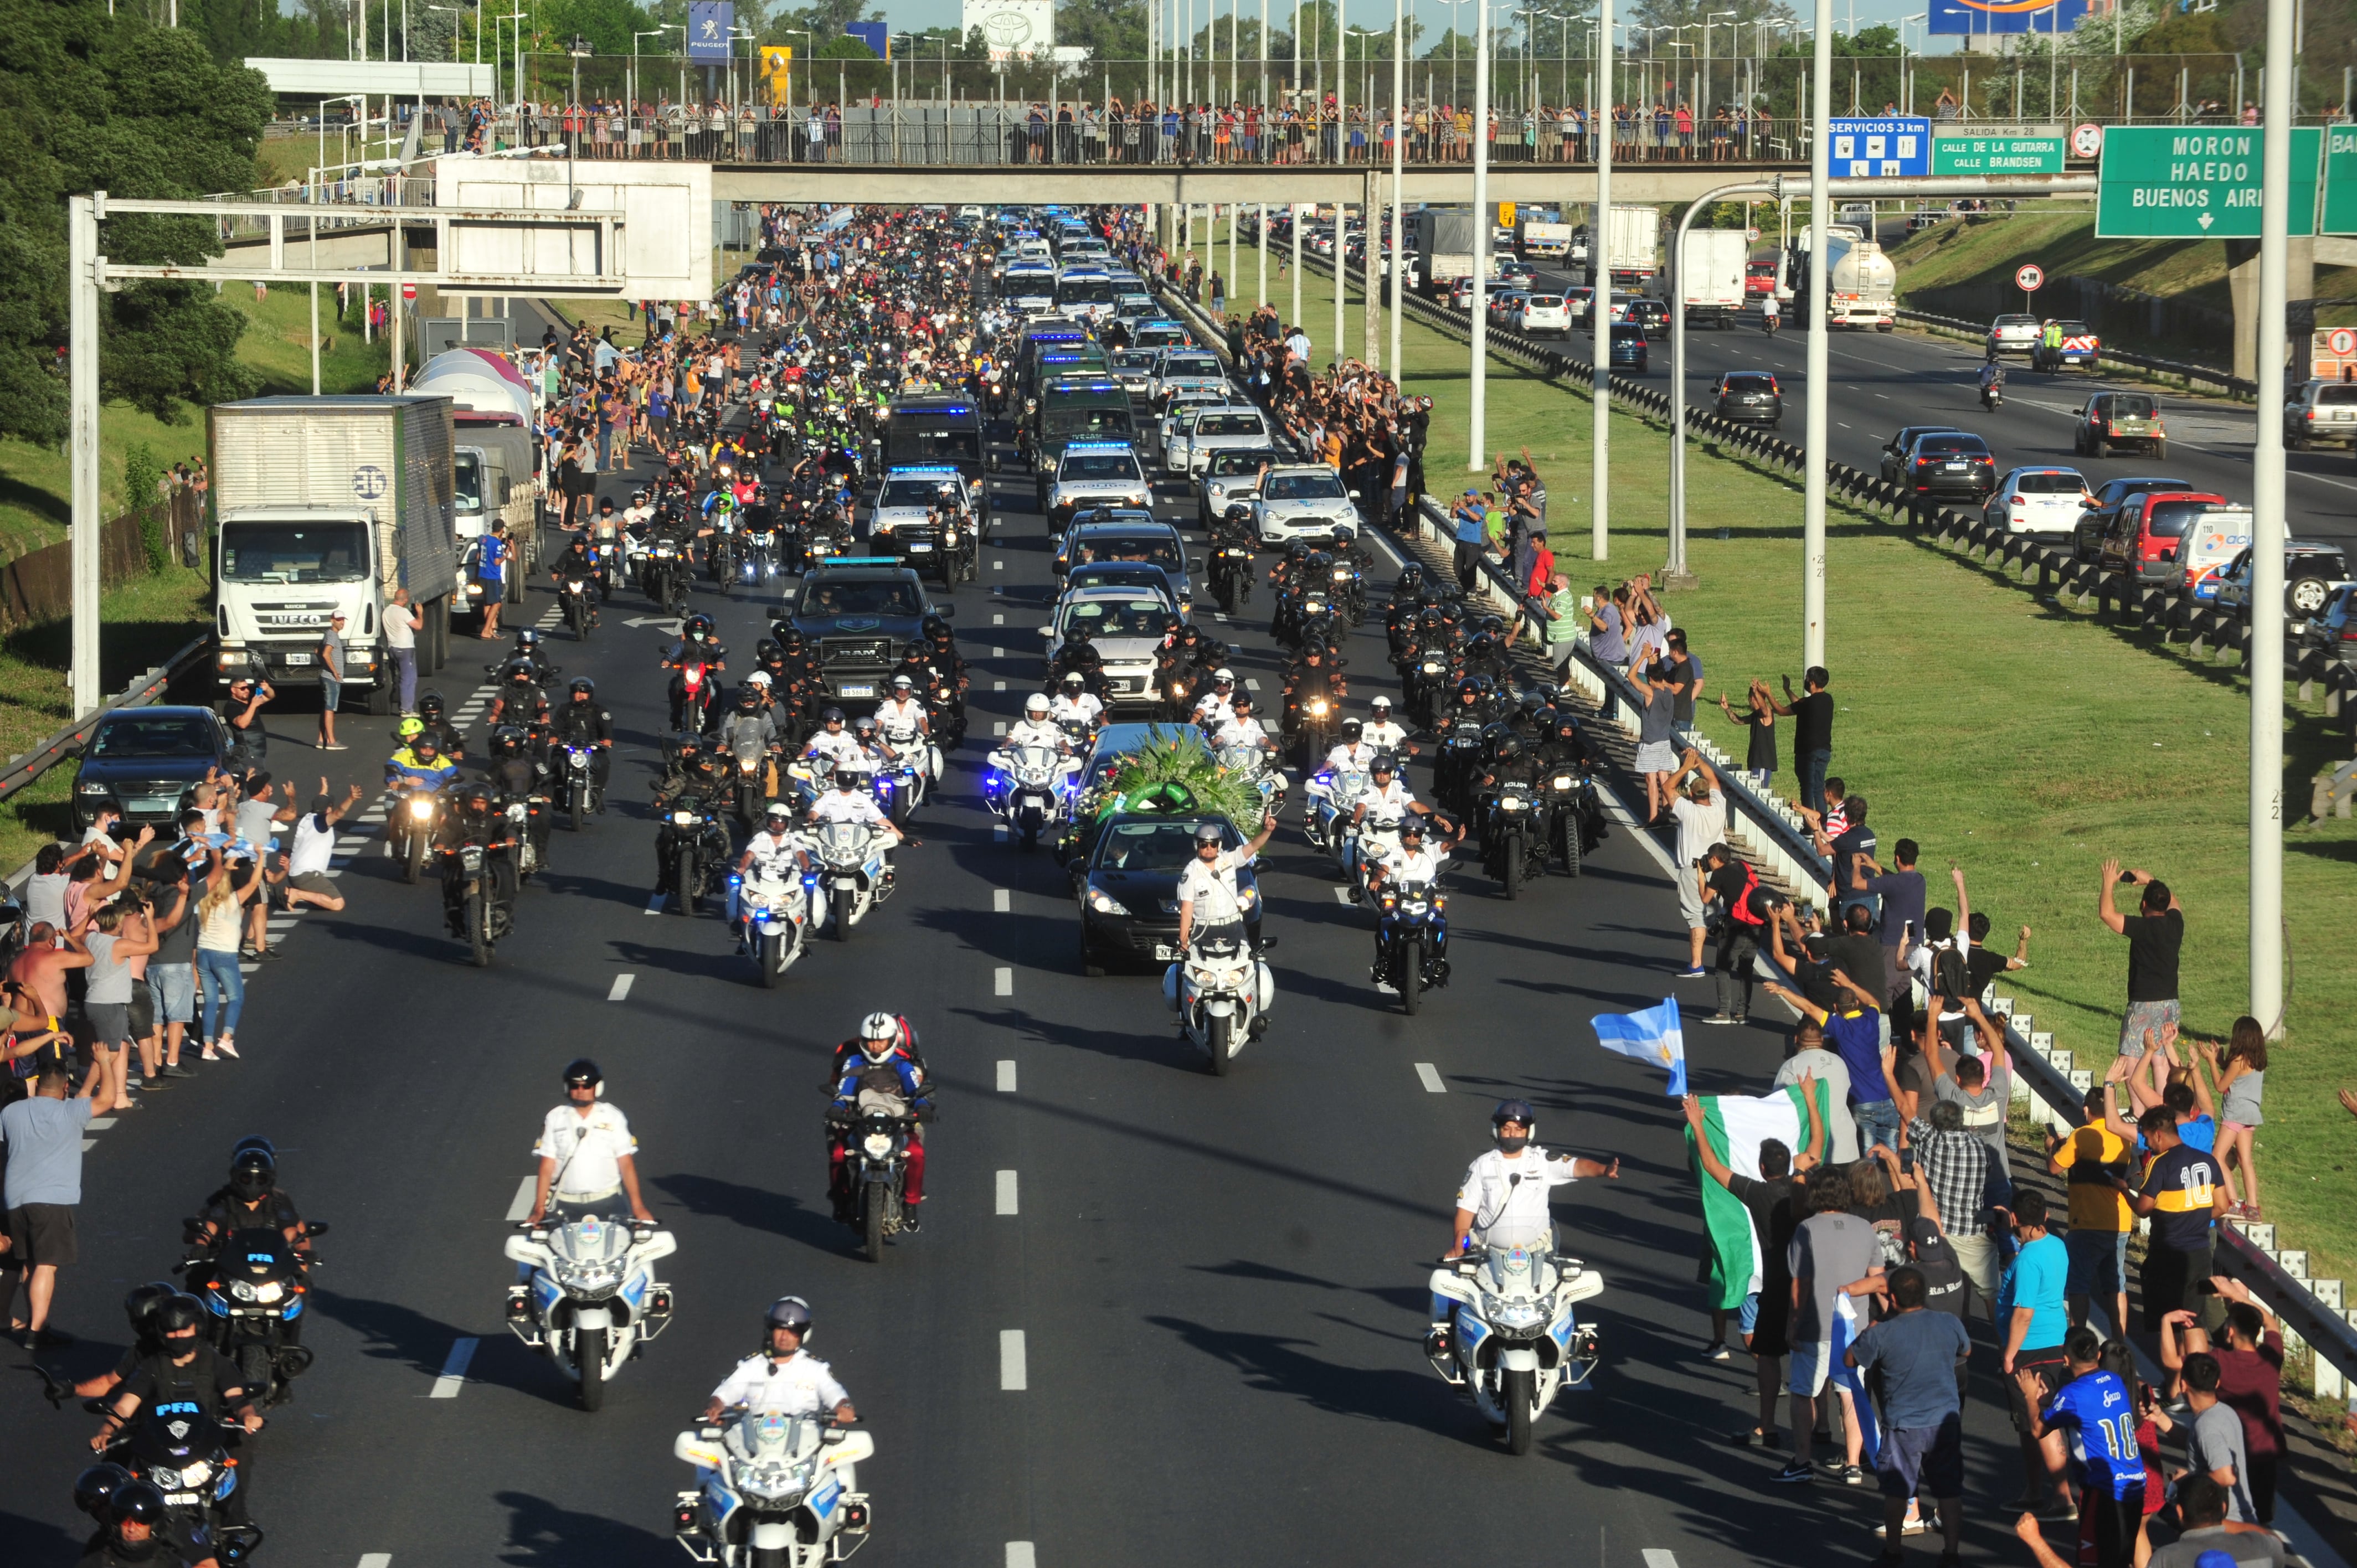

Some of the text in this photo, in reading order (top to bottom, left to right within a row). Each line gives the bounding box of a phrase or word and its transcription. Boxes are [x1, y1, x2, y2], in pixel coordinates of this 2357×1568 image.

[1829, 123, 1925, 132] SERVICIOS 3 km
[1963, 128, 1996, 136] SALIDA
[2024, 127, 2035, 136] 28
[1942, 142, 2055, 153] CALLE DE LA GUITARRA
[2173, 136, 2251, 156] MORON
[1954, 157, 2042, 167] CALLE BRANDSEN
[2170, 162, 2248, 181] HAEDO
[2132, 188, 2262, 208] BUENOS AIR
[2203, 525, 2214, 534] 110
[271, 615, 321, 625] IVECO
[1157, 948, 1171, 957] NZW
[2180, 1162, 2212, 1208] 10
[248, 1252, 274, 1263] PFA
[156, 1402, 200, 1417] PFA
[2097, 1413, 2138, 1461] 10
